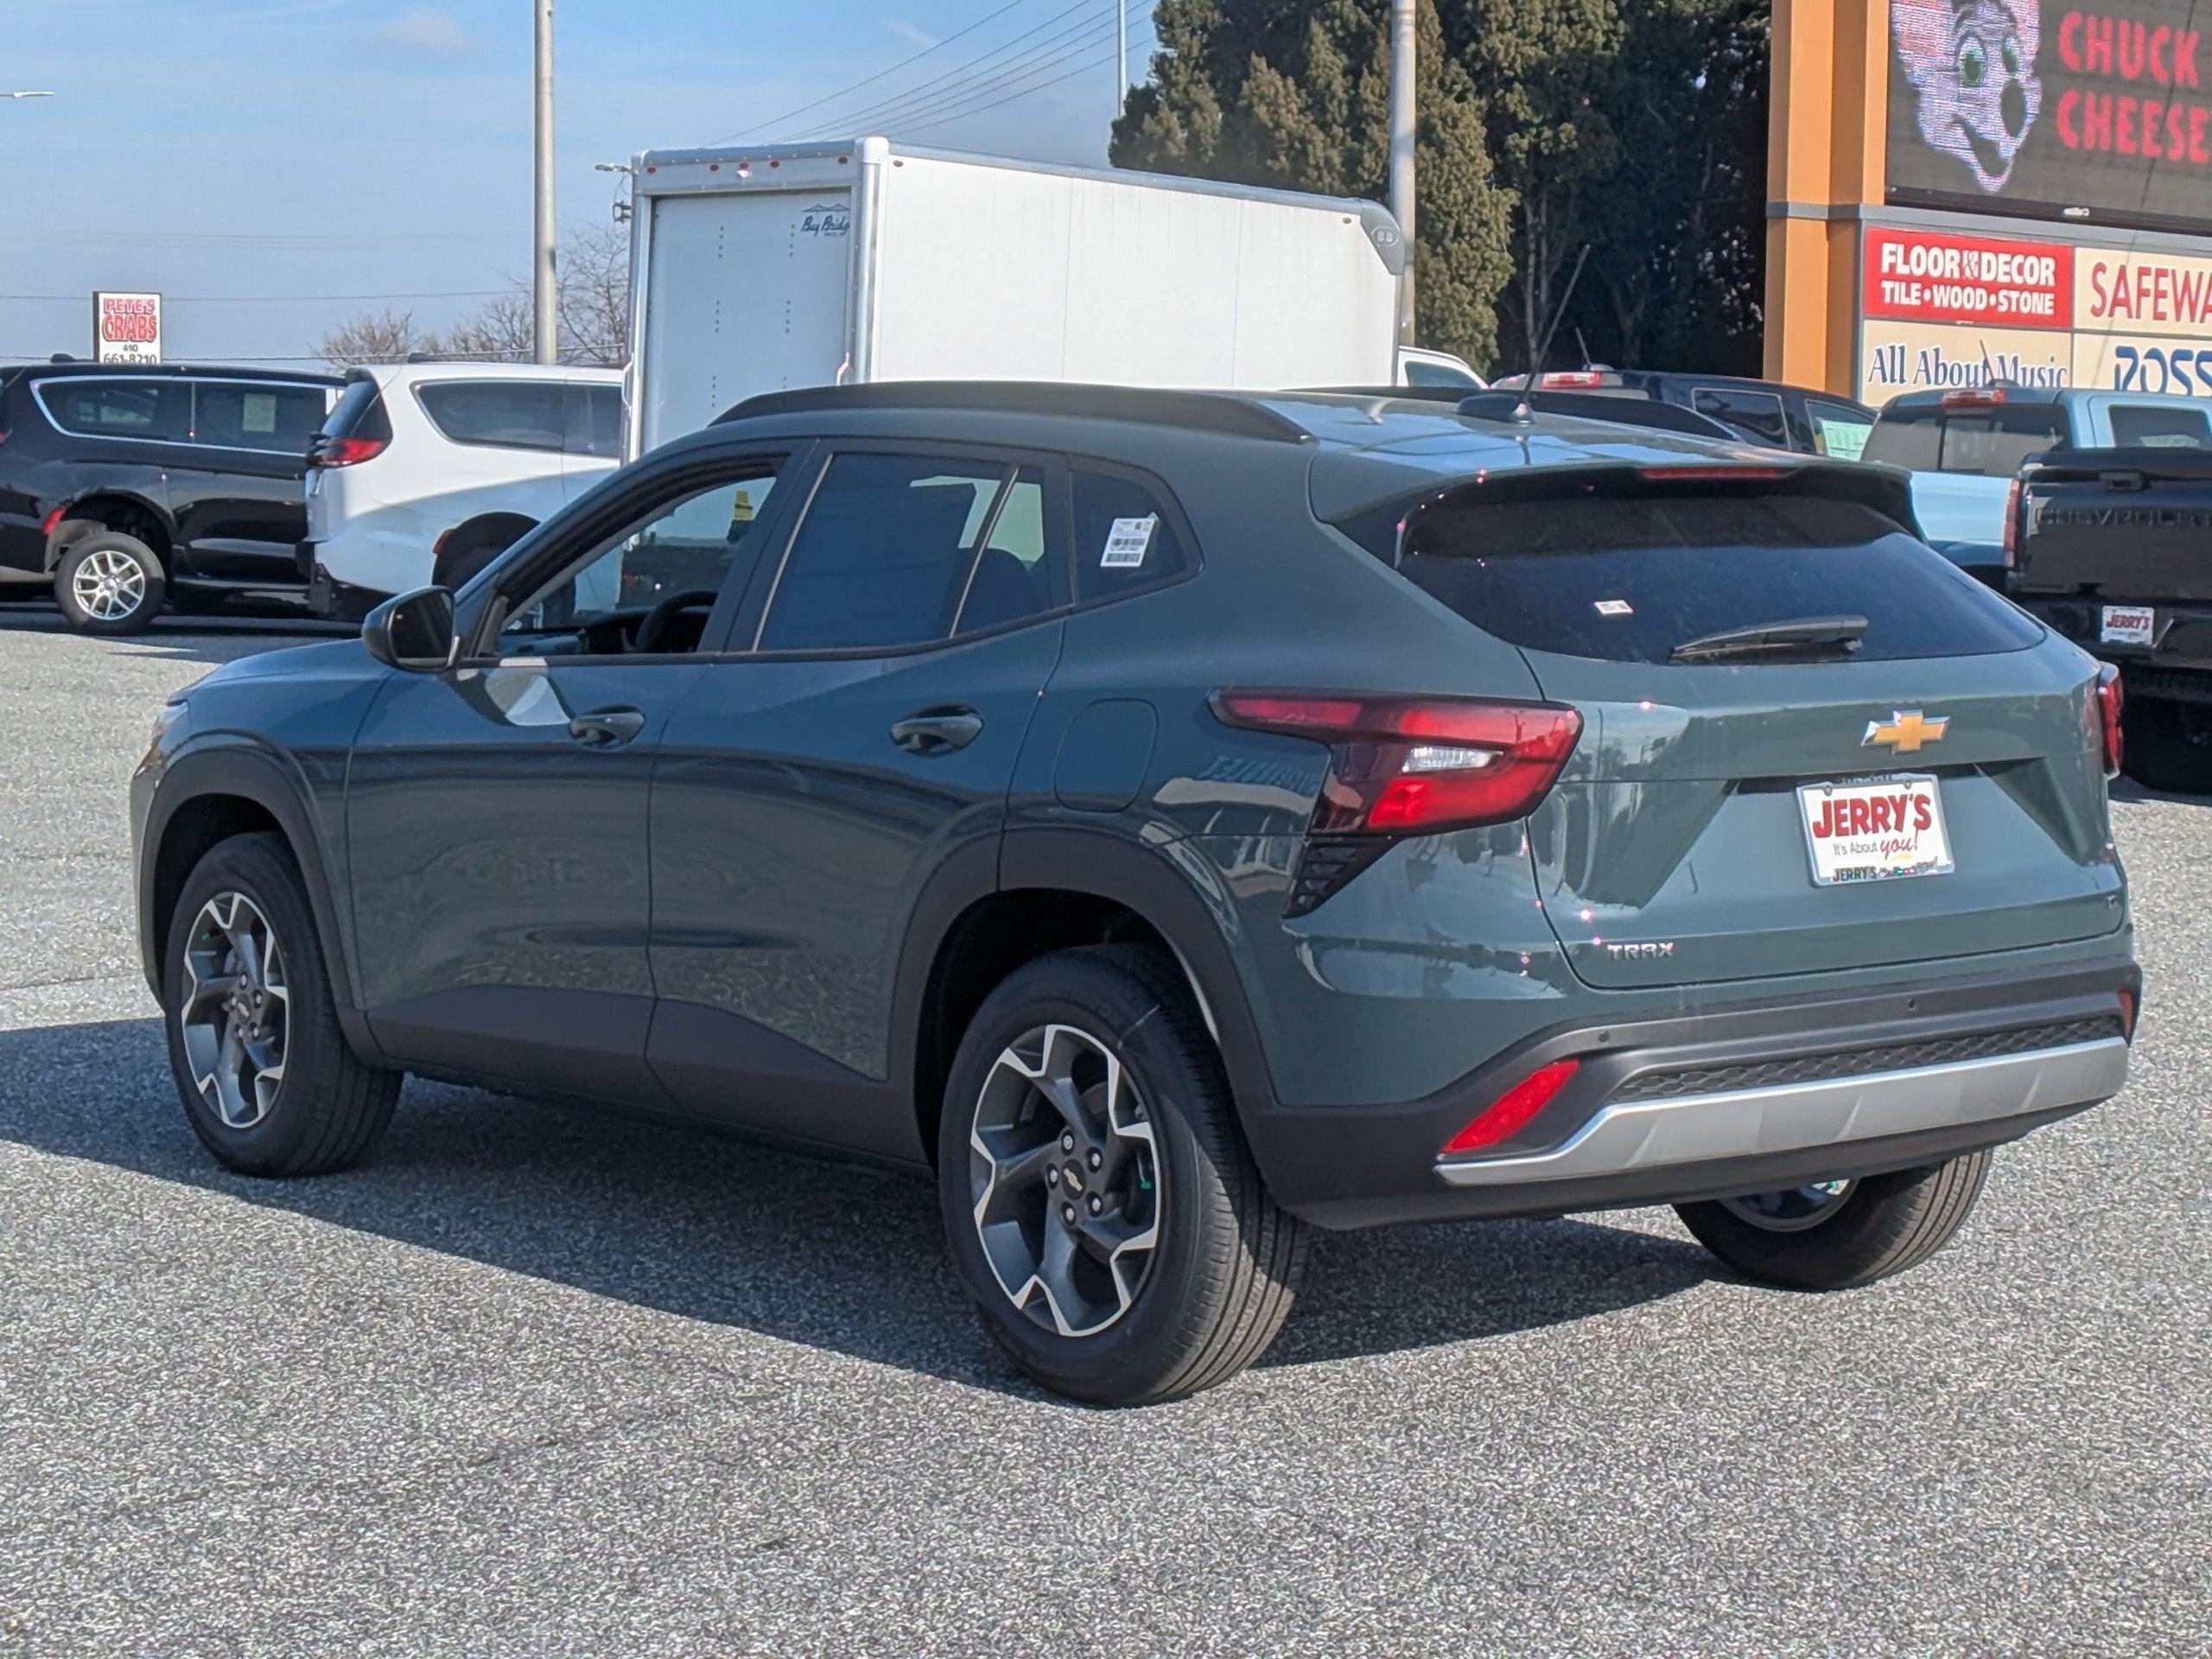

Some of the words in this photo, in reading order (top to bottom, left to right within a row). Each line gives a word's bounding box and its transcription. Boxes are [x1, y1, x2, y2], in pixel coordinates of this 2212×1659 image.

[2058, 11, 2200, 86] CHUCK
[2056, 89, 2209, 163] CHEESE
[801, 214, 820, 237] Bay
[1881, 242, 1961, 279] FLOOR
[1980, 251, 2056, 286] DECOR
[1881, 280, 1922, 305] TILE
[1932, 284, 1987, 310] WOOD
[1997, 289, 2055, 315] STONE
[102, 314, 157, 342] CRABS
[1868, 344, 1906, 384] All
[1913, 346, 1991, 387] About
[1996, 353, 2067, 387] Music
[2106, 614, 2150, 630] JERRY'S
[1812, 793, 1932, 838] JERRY'S
[1834, 842, 1848, 855] It's
[1850, 841, 1878, 854] About
[1607, 942, 1675, 959] TRAX
